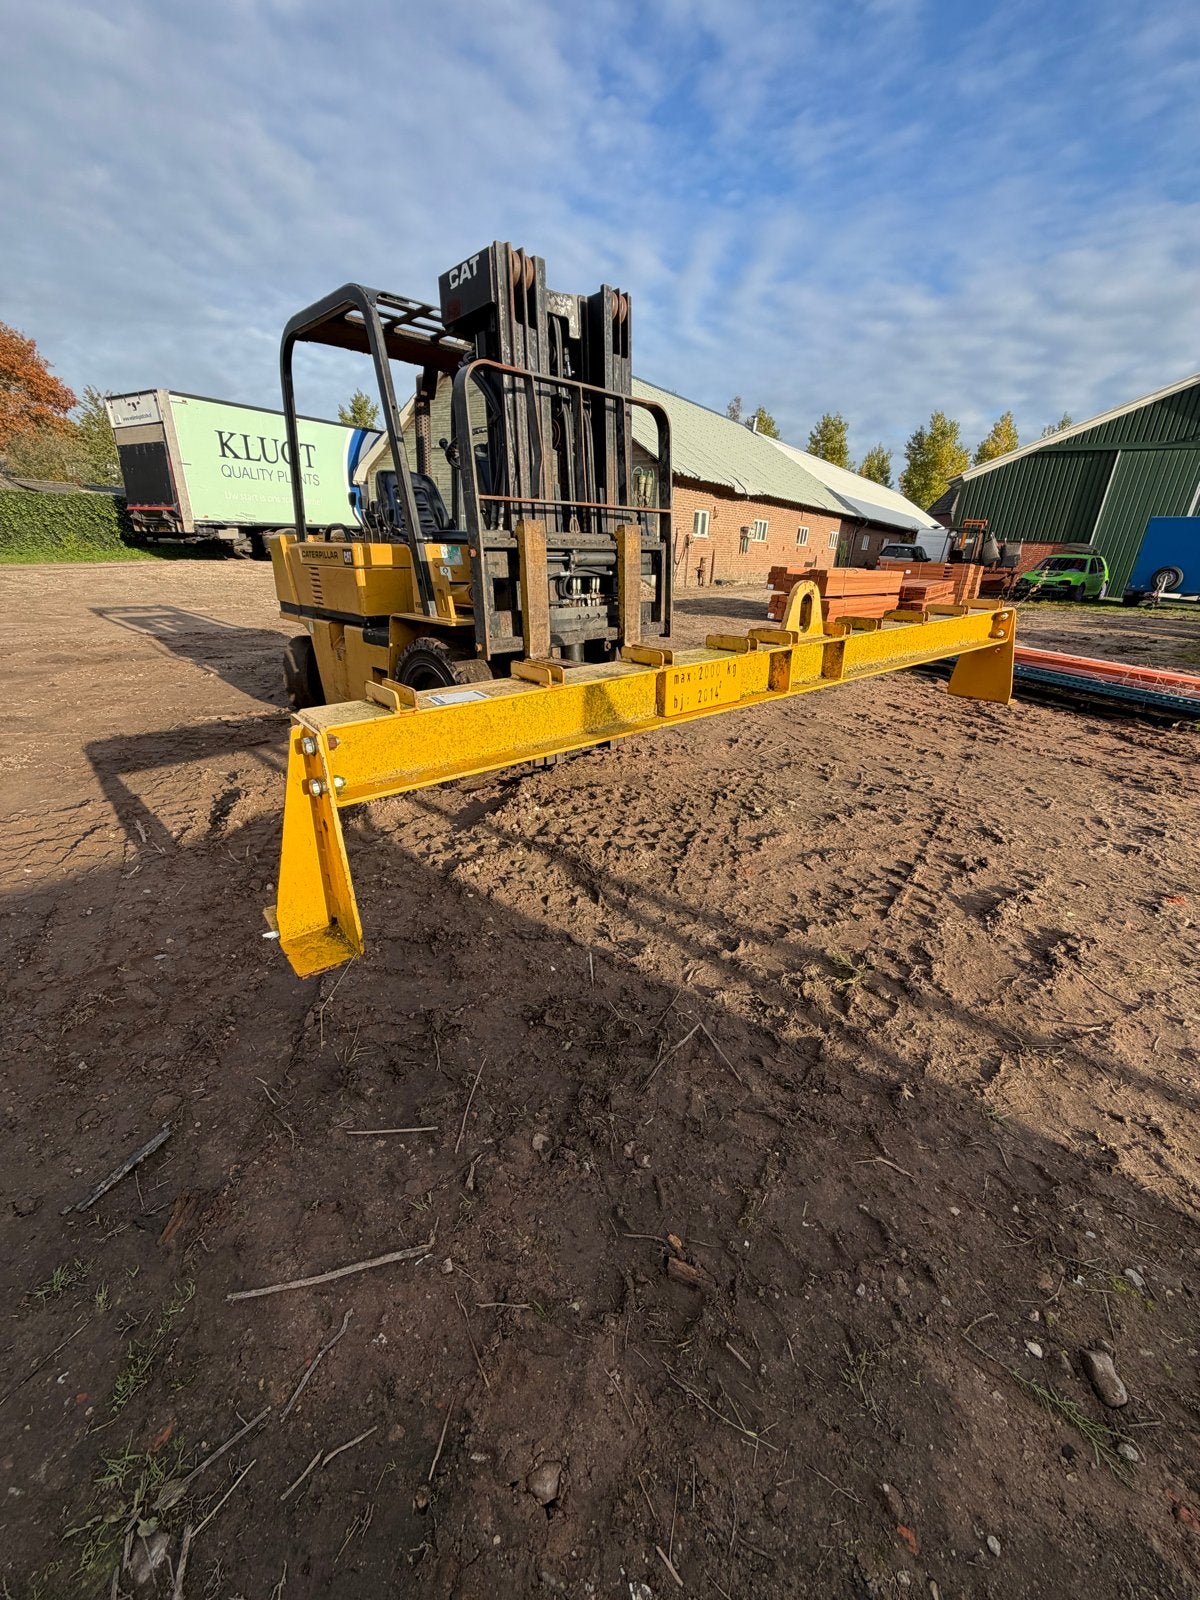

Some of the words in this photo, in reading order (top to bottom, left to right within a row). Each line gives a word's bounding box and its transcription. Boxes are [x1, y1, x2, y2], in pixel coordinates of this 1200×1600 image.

[449, 254, 480, 290] CAT
[221, 464, 274, 482] QUALITY
[277, 470, 320, 487] PLNTS
[301, 550, 339, 560] CATERPILLAR
[727, 661, 737, 677] kg
